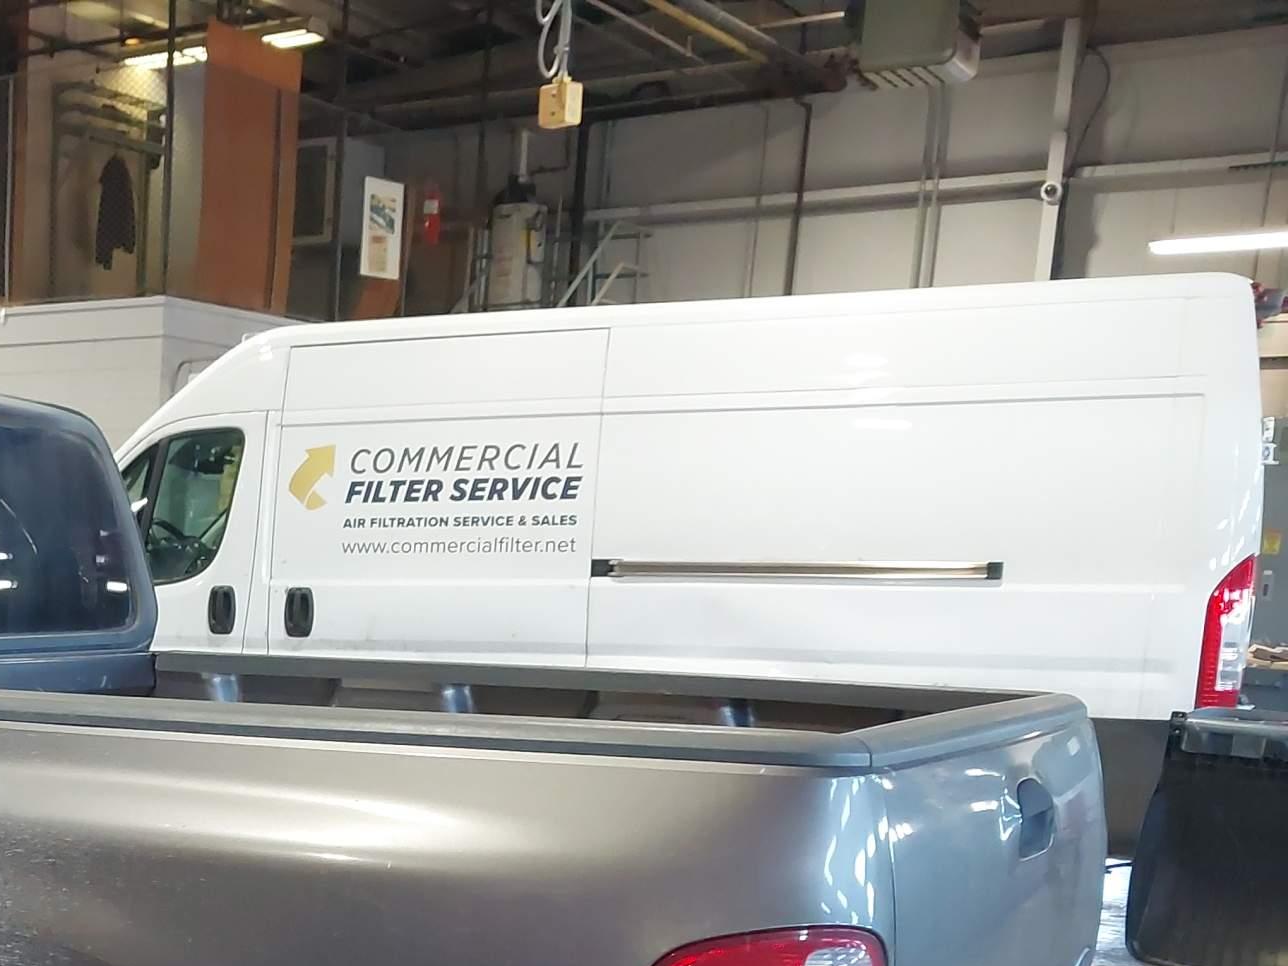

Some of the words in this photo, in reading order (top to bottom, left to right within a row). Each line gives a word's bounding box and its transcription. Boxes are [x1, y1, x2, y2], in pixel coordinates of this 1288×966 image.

[350, 442, 584, 474] COMMERCIAL
[344, 478, 444, 504] FILTER
[448, 476, 584, 503] SERVICE
[342, 518, 366, 529] AIR
[369, 516, 450, 528] FILTRATION
[453, 515, 513, 527] SERVICE
[518, 516, 527, 526] &
[531, 514, 578, 526] SALES
[342, 537, 577, 554] www.commercialfilter.net
